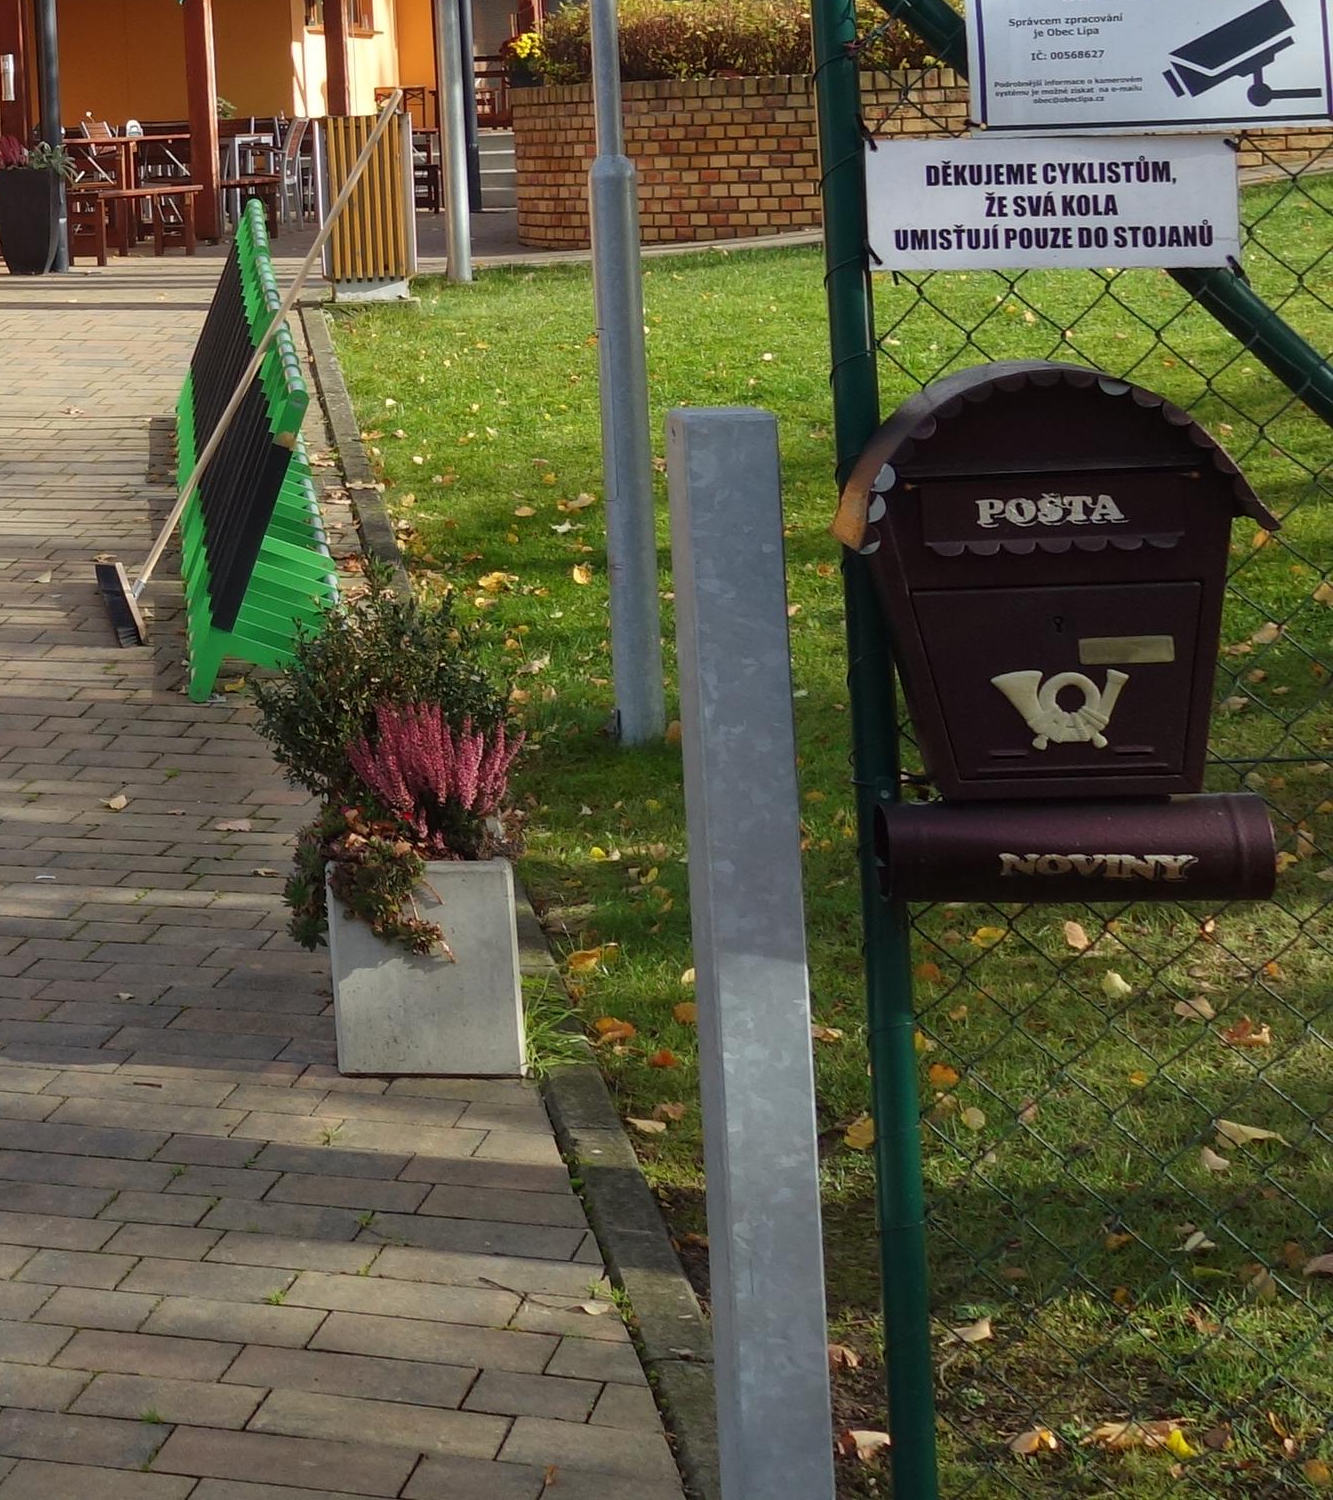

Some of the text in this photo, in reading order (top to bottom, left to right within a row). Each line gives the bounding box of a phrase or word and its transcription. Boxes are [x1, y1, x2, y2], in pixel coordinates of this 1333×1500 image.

[1008, 12, 1124, 28] Správcem zpracování
[1033, 28, 1044, 39] je
[1046, 27, 1074, 37] Obec
[1031, 49, 1105, 61] IČ: 00568627
[926, 155, 1177, 186] DĚKUJEME CYKLISTŮM,
[985, 191, 1118, 217] ŽE SVÁ KOLA
[894, 219, 1213, 250] UMISŤUJÍ POUZE DO STOJANŮ
[975, 492, 1130, 528] POŠTA
[998, 852, 1199, 882] NOVINY
